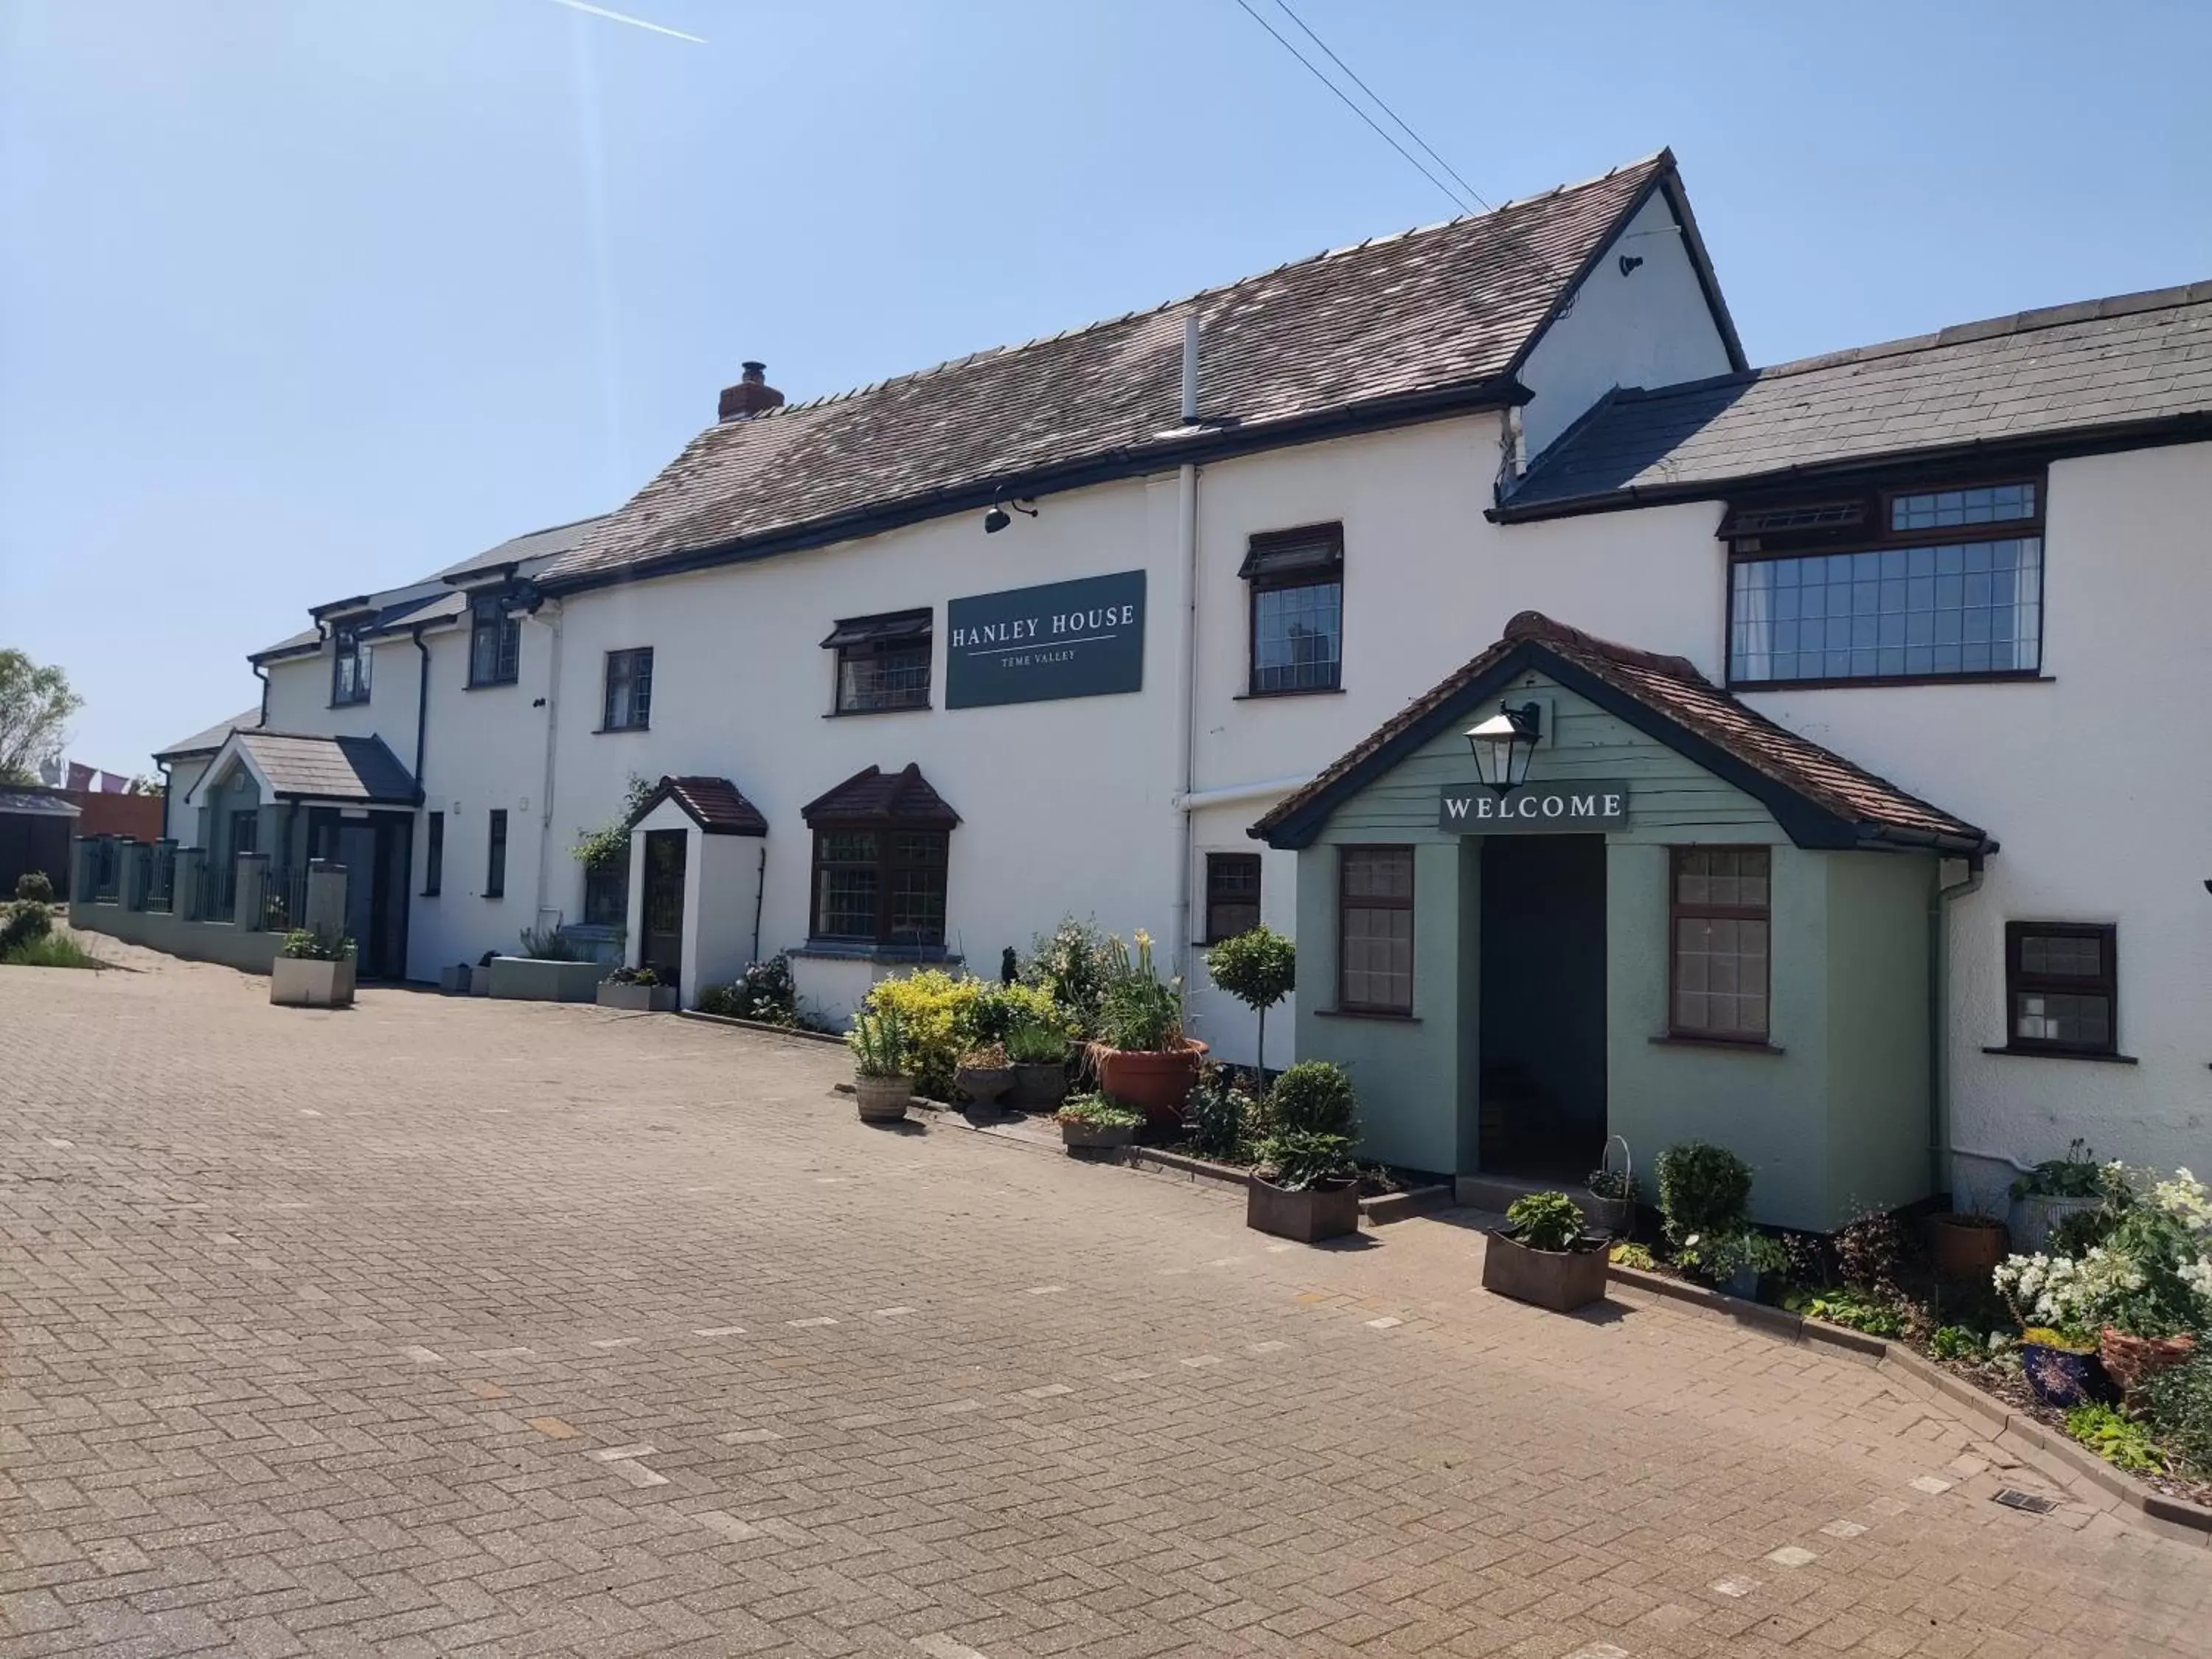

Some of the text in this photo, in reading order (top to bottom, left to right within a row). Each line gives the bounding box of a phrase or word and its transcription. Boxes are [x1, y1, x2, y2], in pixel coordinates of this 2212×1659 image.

[953, 605, 1134, 647] HANLEY HOUSE
[1002, 650, 1076, 667] TEME VALLEY
[1444, 794, 1621, 818] WELCOME
